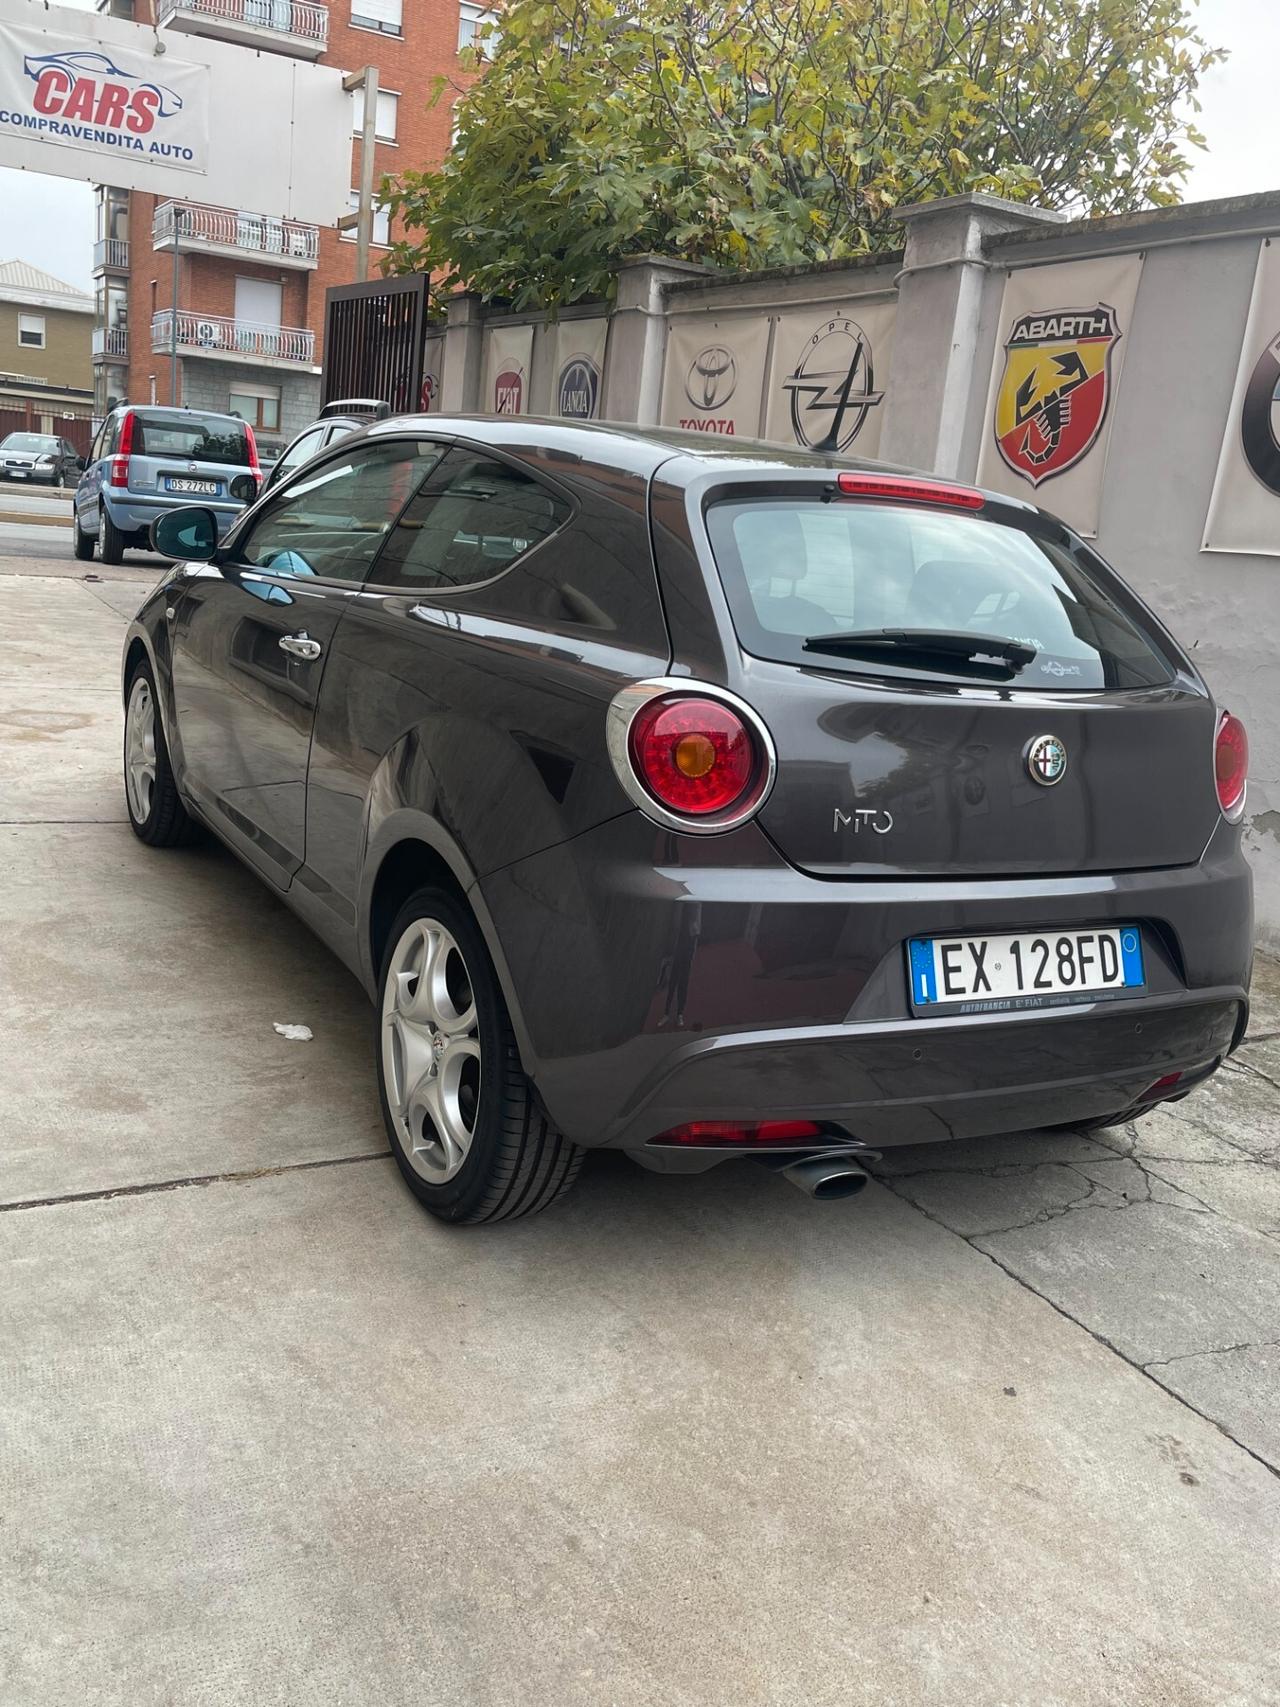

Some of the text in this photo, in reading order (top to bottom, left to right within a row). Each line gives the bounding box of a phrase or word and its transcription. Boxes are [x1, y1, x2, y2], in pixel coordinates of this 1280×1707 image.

[33, 70, 160, 134] CARS
[0, 109, 194, 161] COMPRAVENDITA AUTO
[811, 321, 864, 345] OPEL
[1012, 316, 1107, 341] ABARTH
[562, 390, 588, 413] LANCIA
[679, 418, 736, 436] TOYOTA
[941, 933, 1119, 996] EX 128FD
